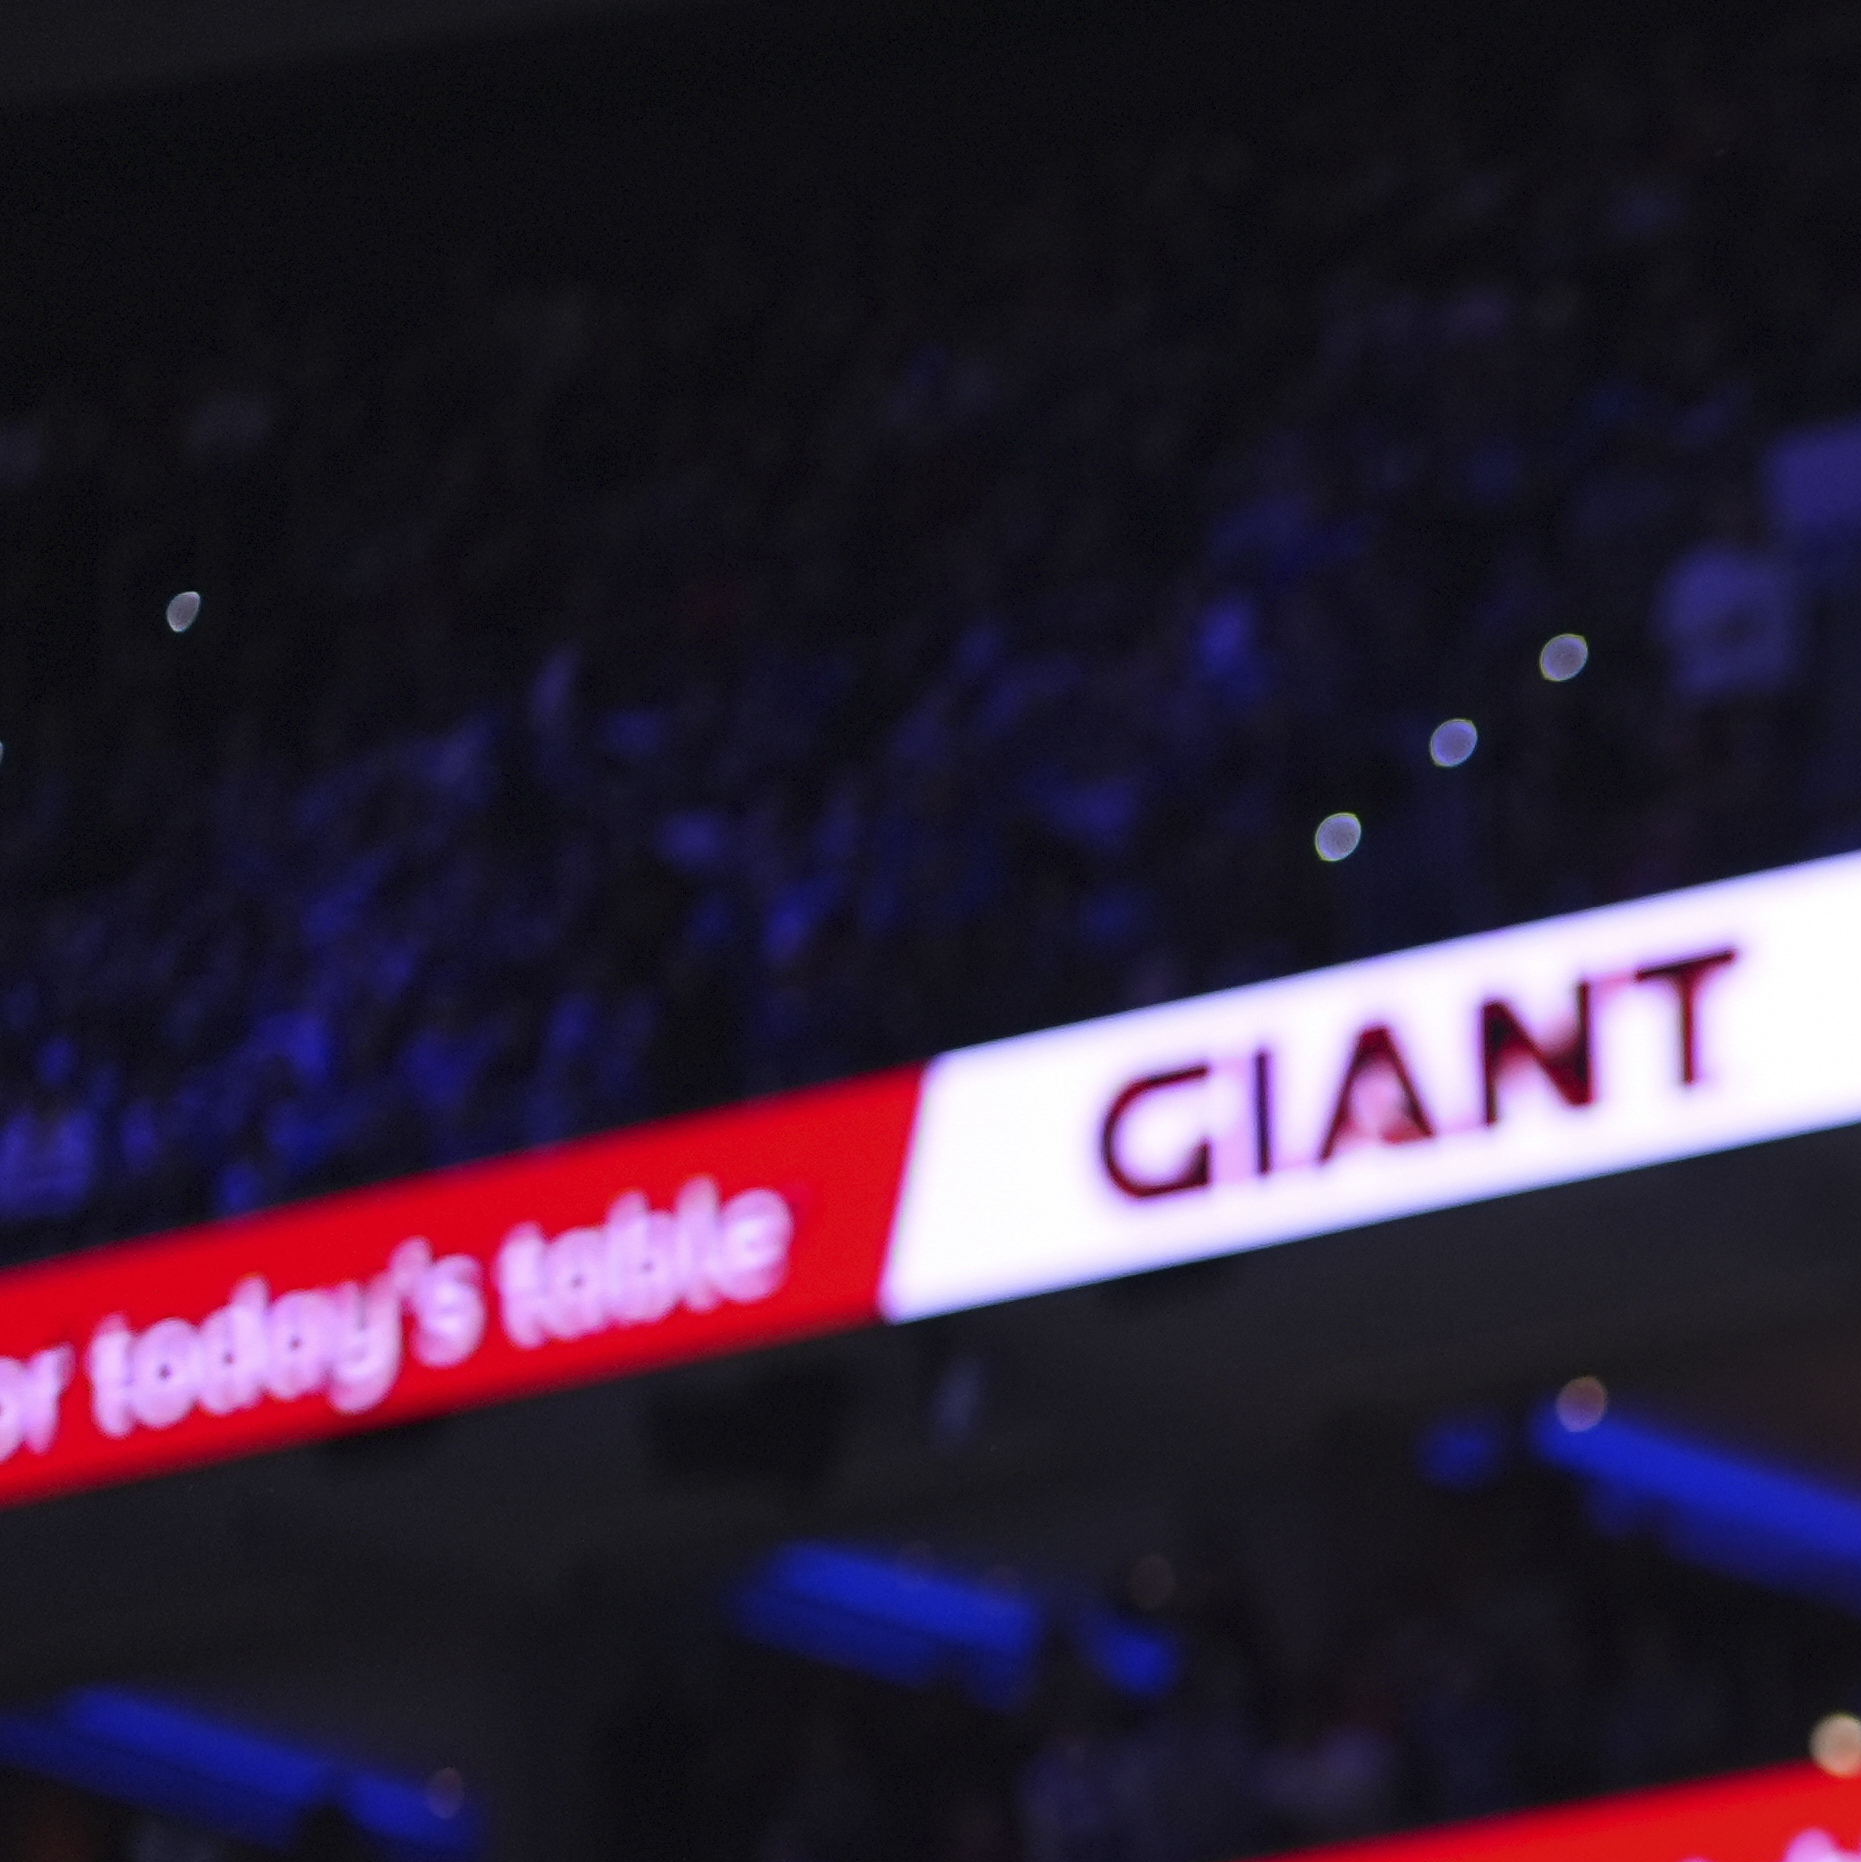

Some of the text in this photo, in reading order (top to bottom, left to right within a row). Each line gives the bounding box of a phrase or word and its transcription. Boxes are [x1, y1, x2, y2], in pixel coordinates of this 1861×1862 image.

[1101, 948, 1736, 1199] GIANT
[84, 1237, 487, 1414] today's
[497, 1176, 795, 1349] table
